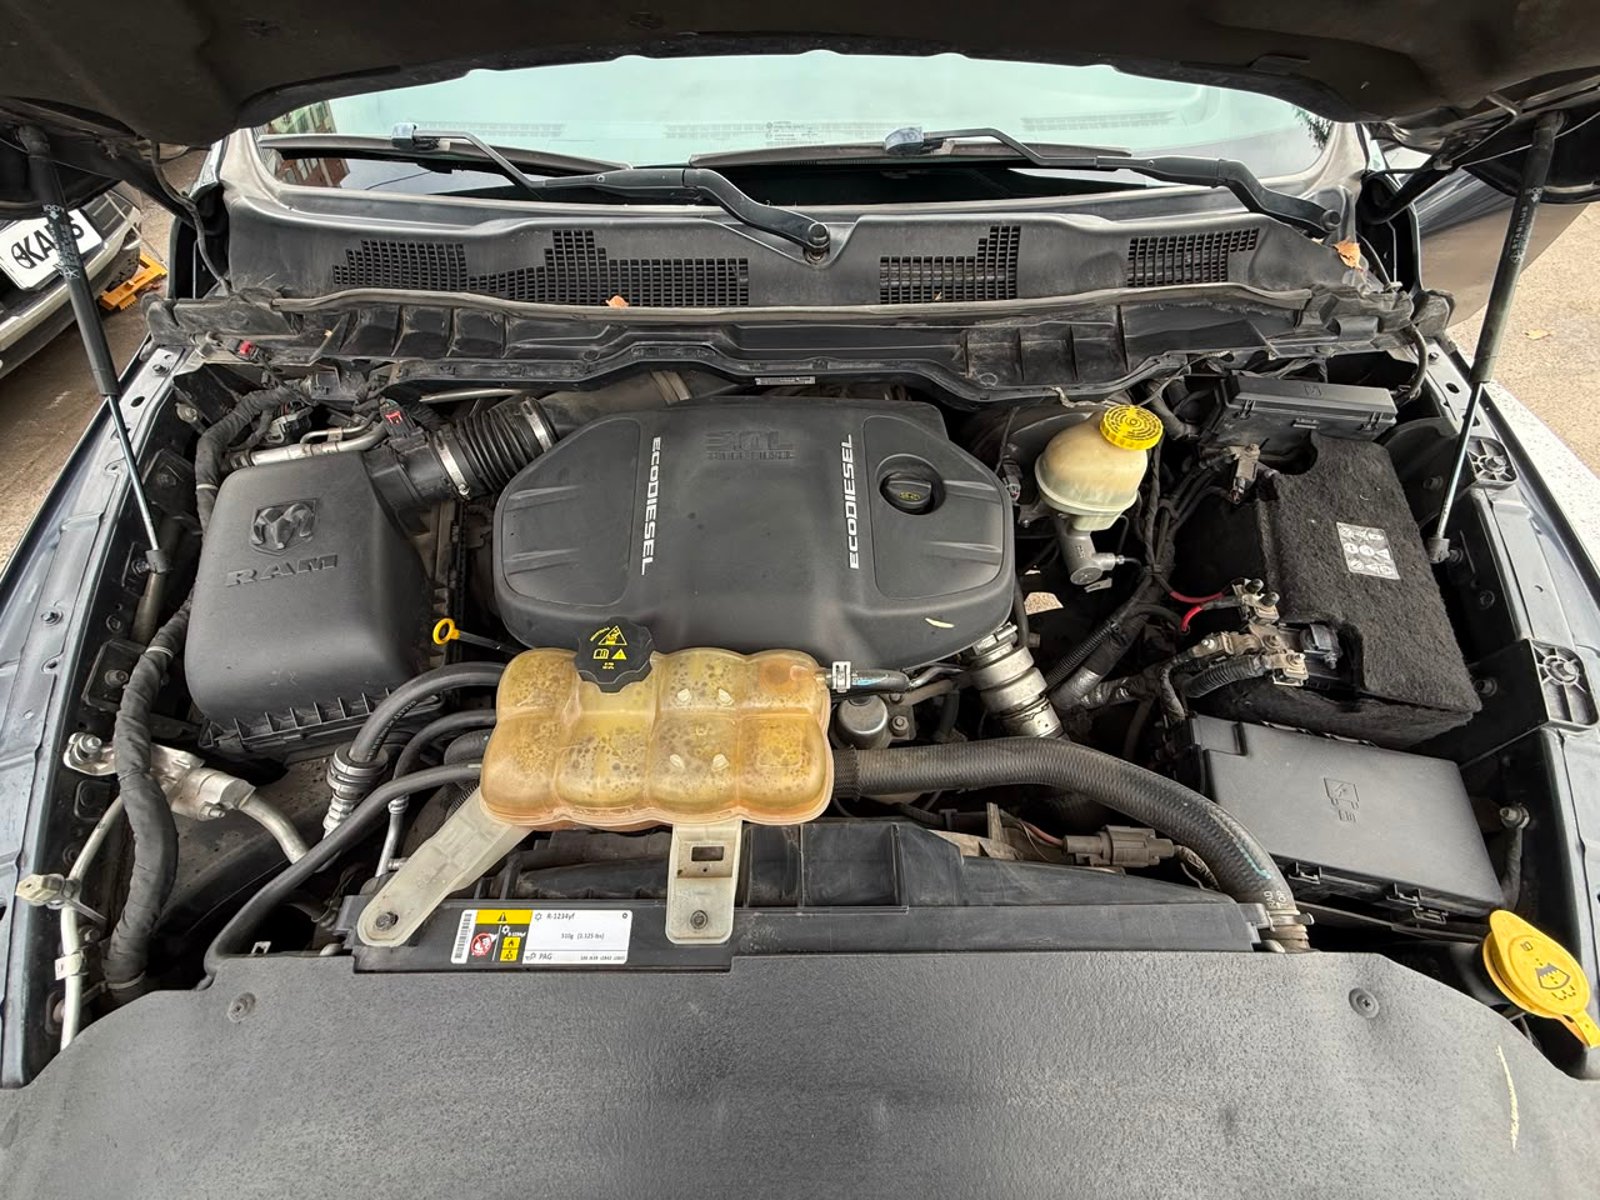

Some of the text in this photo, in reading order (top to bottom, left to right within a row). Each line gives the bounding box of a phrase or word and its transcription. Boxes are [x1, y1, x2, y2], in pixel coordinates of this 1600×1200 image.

[641, 436, 661, 576] ECODIESEL
[841, 433, 860, 570] ECODIESEL
[225, 554, 338, 588] RAM
[546, 912, 575, 920] R-1234yf
[539, 952, 553, 960] PAG
